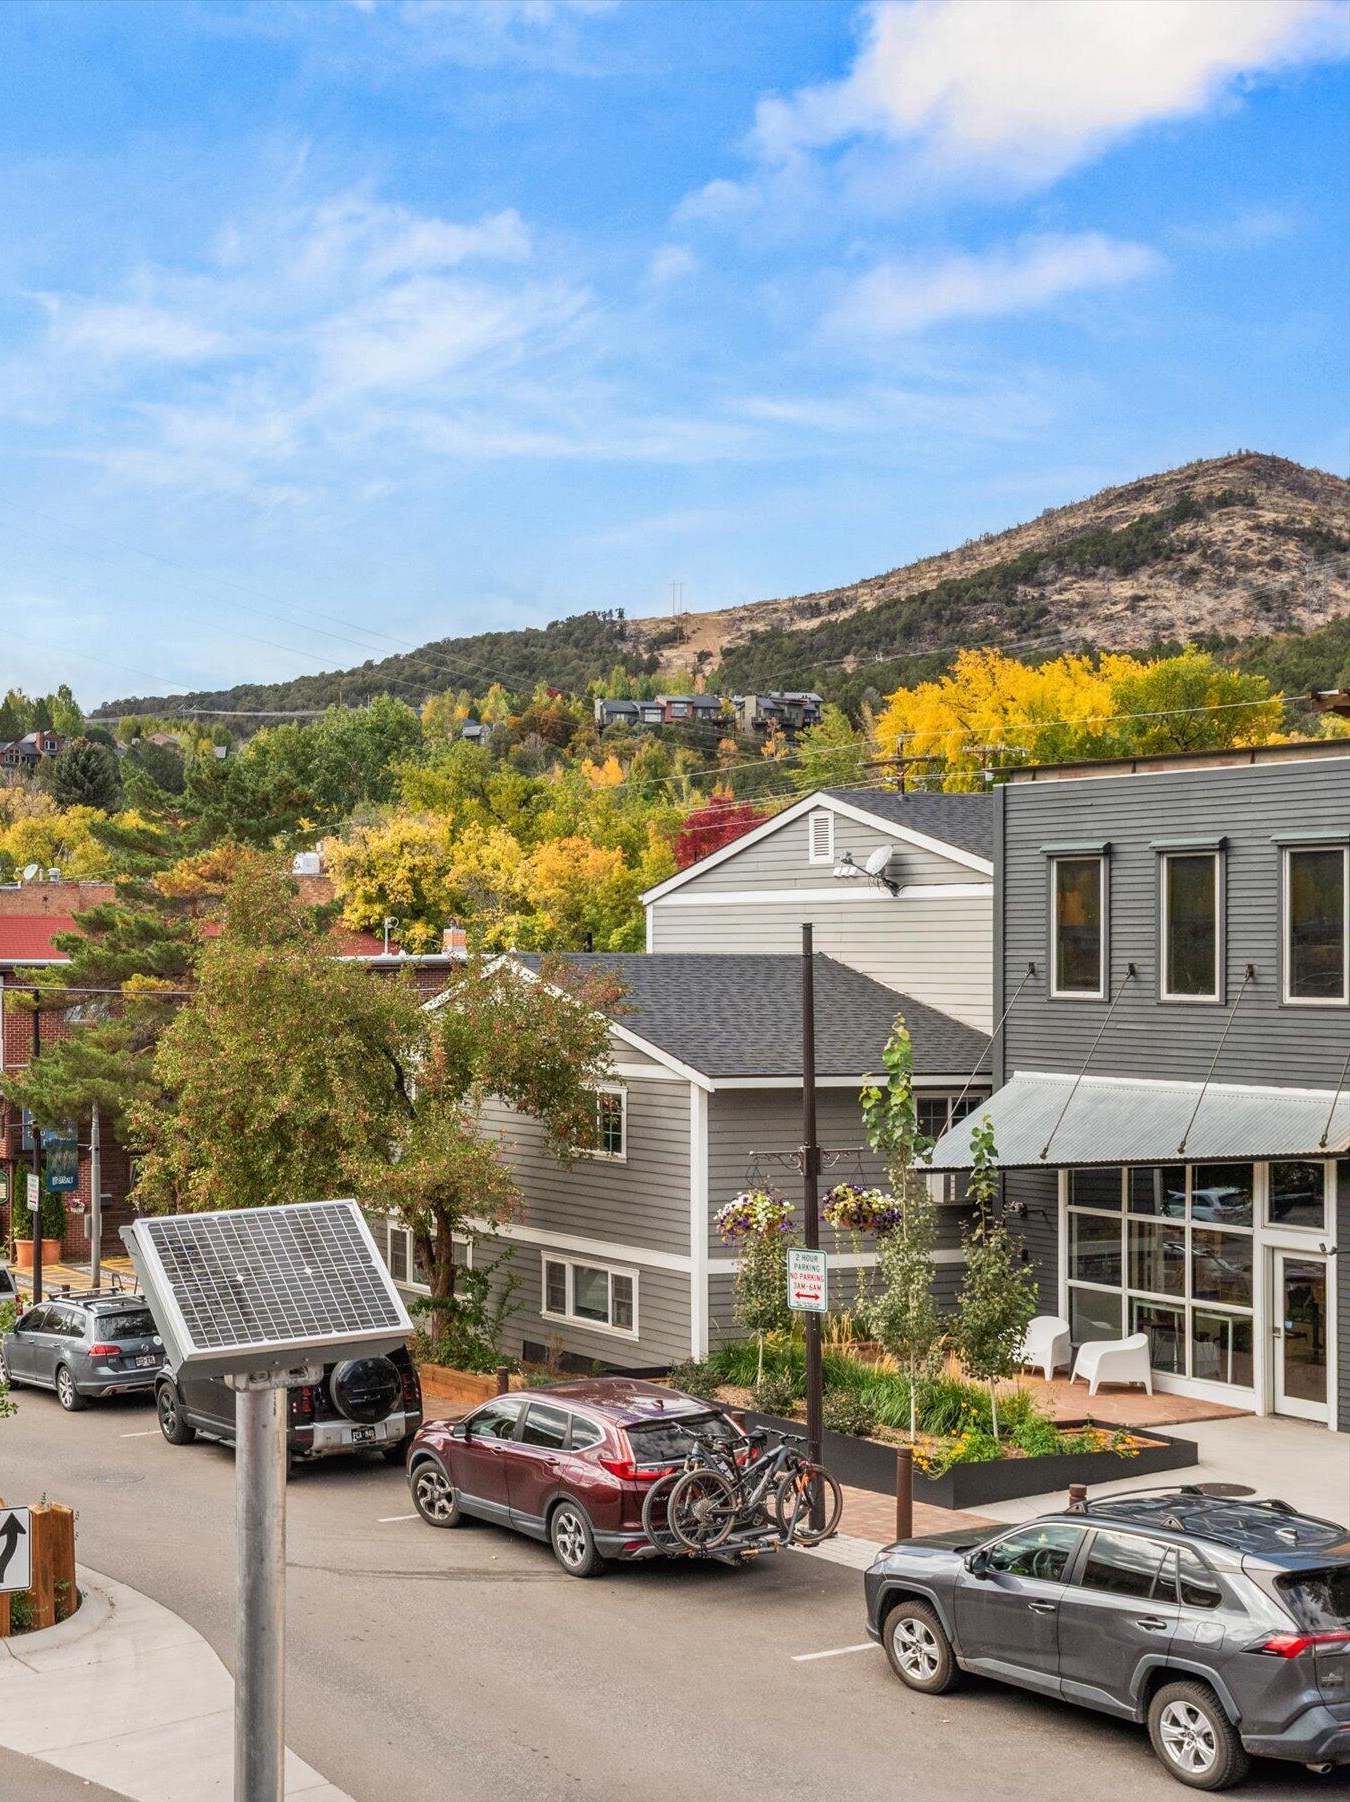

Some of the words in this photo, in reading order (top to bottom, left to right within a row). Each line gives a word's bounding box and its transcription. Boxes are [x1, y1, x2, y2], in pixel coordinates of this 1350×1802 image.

[802, 1255, 819, 1263] HOUR
[794, 1262, 820, 1273] PARKING
[790, 1271, 798, 1280] NO
[800, 1272, 825, 1283] PARKING
